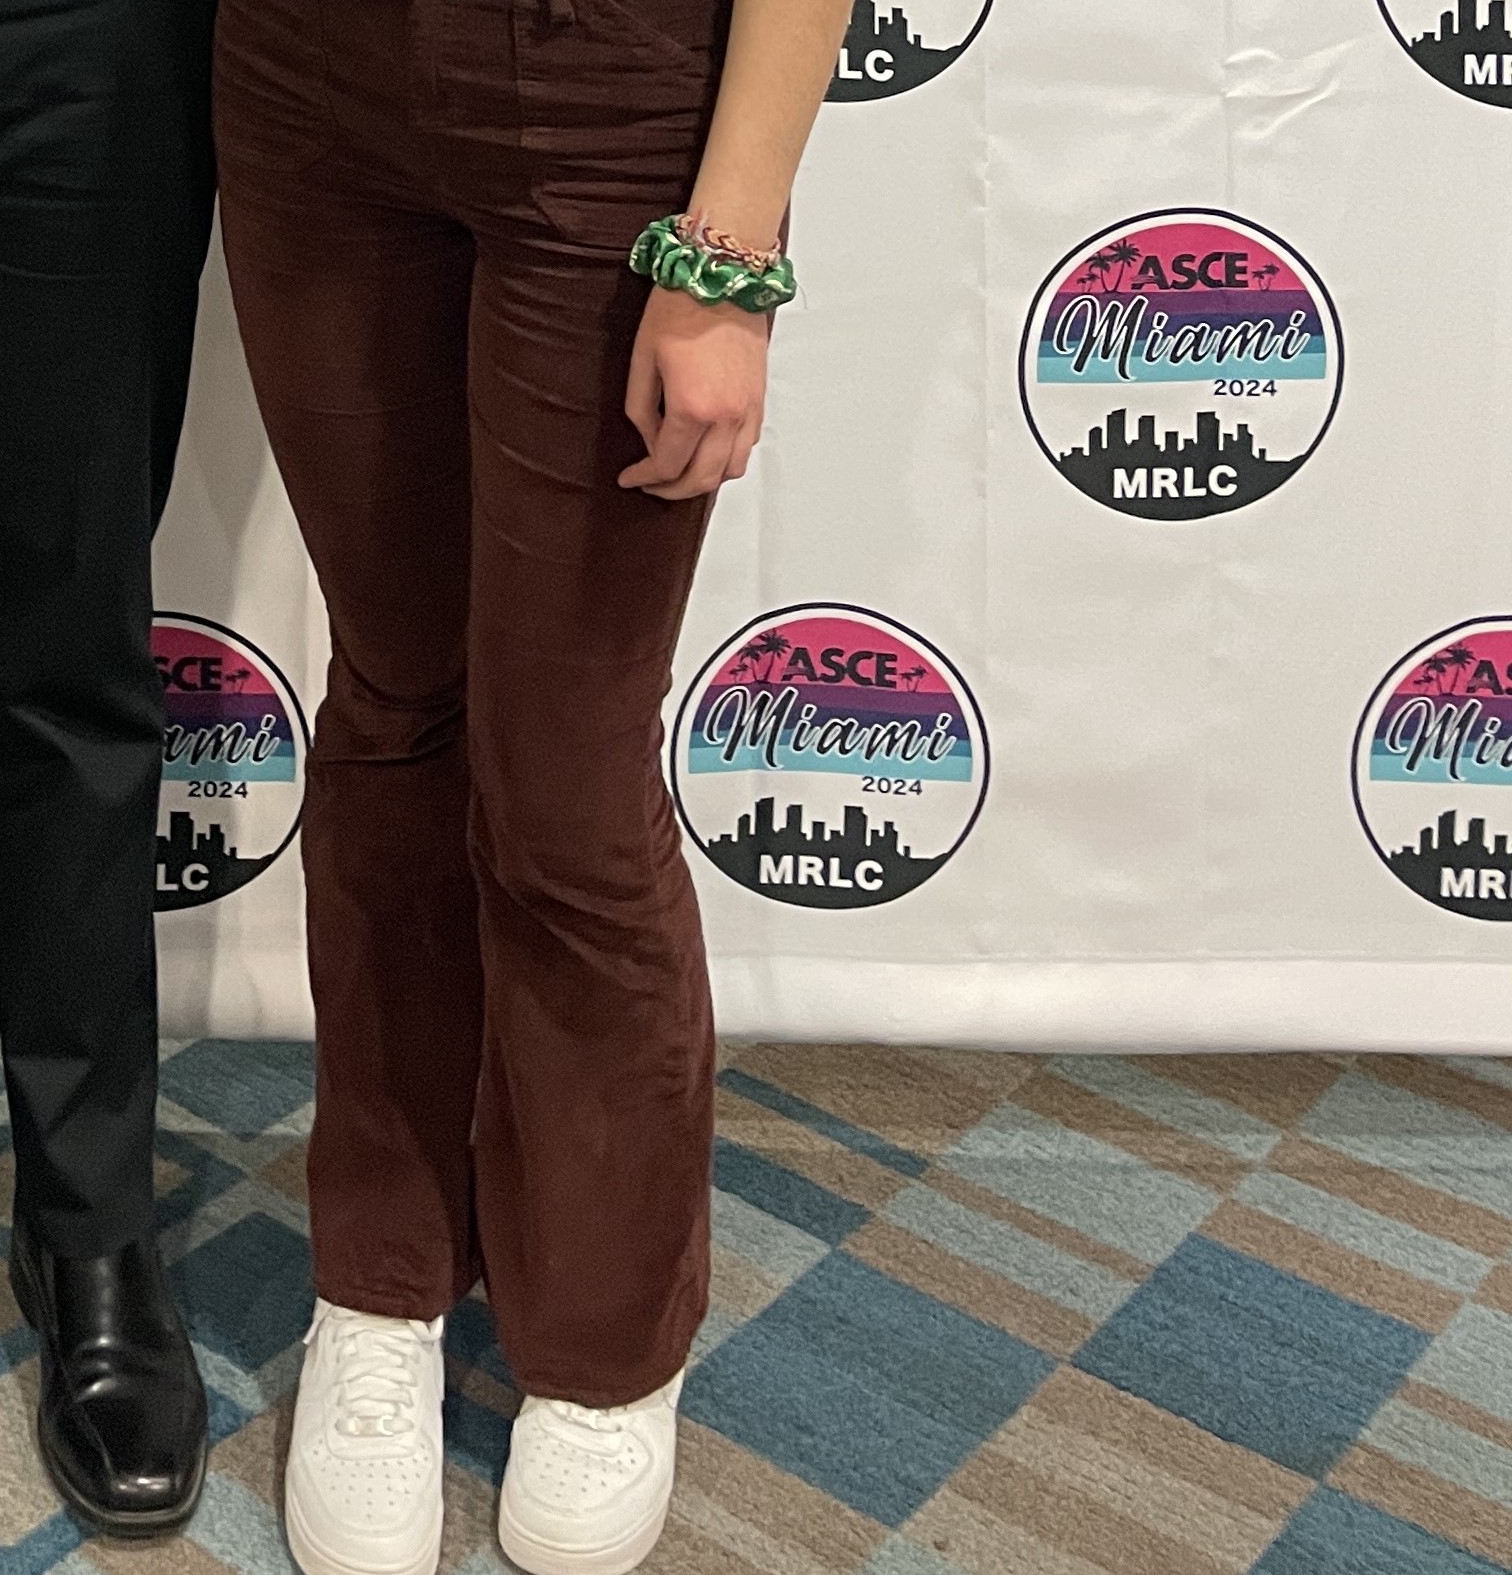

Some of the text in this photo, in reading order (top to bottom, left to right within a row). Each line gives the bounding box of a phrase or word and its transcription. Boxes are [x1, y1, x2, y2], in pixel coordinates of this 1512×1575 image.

[1130, 251, 1249, 291] ASCE
[1055, 295, 1312, 381] Miami
[1213, 378, 1277, 399] 2024
[1112, 465, 1237, 500] MRLC
[781, 647, 899, 687] ASCE
[703, 687, 957, 768] Miami
[188, 780, 248, 799] 2024
[862, 775, 923, 797] 2024
[156, 863, 210, 892] LC
[759, 854, 883, 891] MRLC
